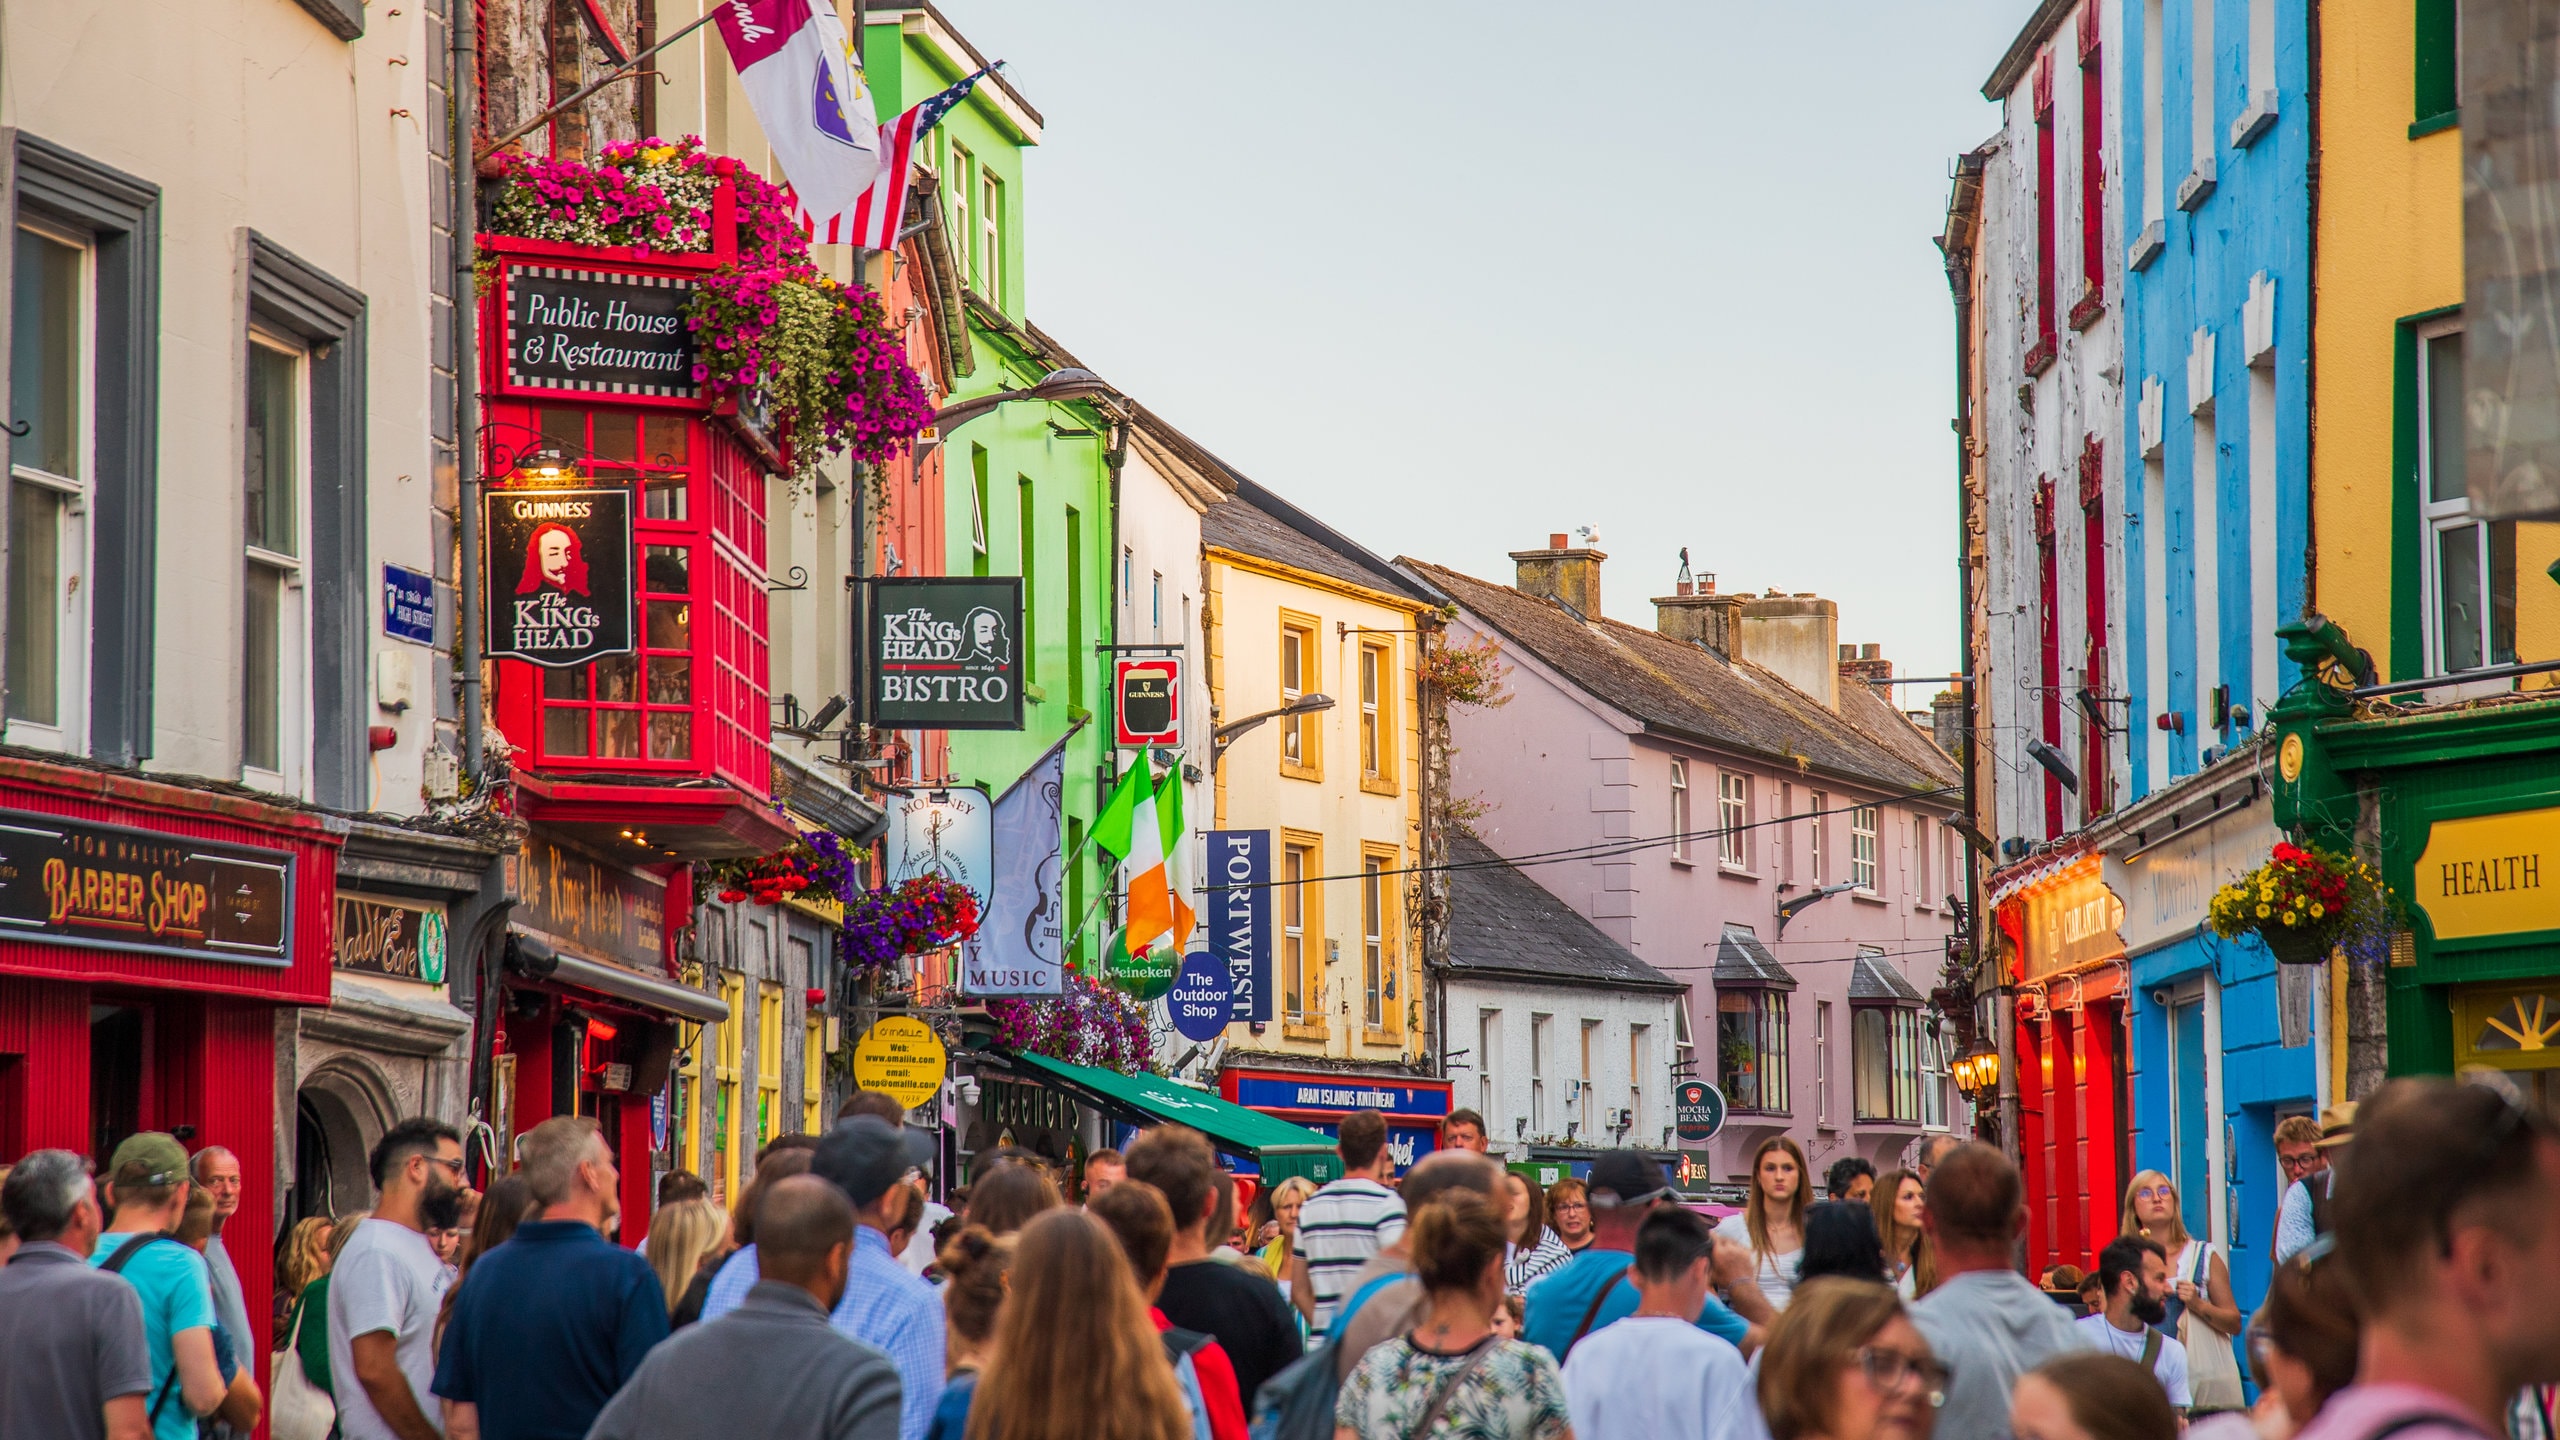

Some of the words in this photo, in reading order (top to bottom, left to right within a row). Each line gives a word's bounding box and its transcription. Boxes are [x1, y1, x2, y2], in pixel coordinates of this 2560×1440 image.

[526, 294, 601, 329] Public
[603, 300, 678, 335] House
[523, 335, 545, 365] &
[549, 333, 685, 371] Restaurant
[922, 428, 935, 438] 20
[513, 500, 592, 519] GUINNESS
[540, 592, 568, 608] The
[397, 605, 412, 622] HIGH
[412, 609, 432, 628] STREET
[907, 608, 932, 621] The
[512, 628, 594, 650] HEAD
[882, 641, 955, 660] HEAD
[882, 676, 1008, 703] BISTRO
[899, 797, 976, 817] MOLNEY
[73, 834, 107, 858] TOM
[909, 849, 931, 866] SALES
[944, 850, 968, 880] REPAIRS
[2441, 854, 2540, 896] HEALTH
[42, 857, 145, 925] BARBER
[149, 869, 207, 937] SHOP
[590, 863, 622, 939] Head
[970, 970, 1046, 987] MUSIC
[1187, 973, 1213, 986] The
[1172, 988, 1228, 1001] Outdoor
[1183, 1004, 1217, 1019] Shop
[890, 1044, 909, 1052] Web:
[865, 1055, 936, 1064] www.omaille.com
[886, 1069, 910, 1077] email:
[862, 1079, 936, 1088] shop@omaille.com
[901, 1095, 920, 1103] 1938
[1297, 1087, 1319, 1104] ARAN
[1321, 1088, 1355, 1106] ISLANDS
[1356, 1091, 1395, 1108] KNITWEAR
[1677, 1105, 1711, 1114] MOCHA
[1680, 1114, 1710, 1122] BEANS
[1678, 1124, 1710, 1132] express
